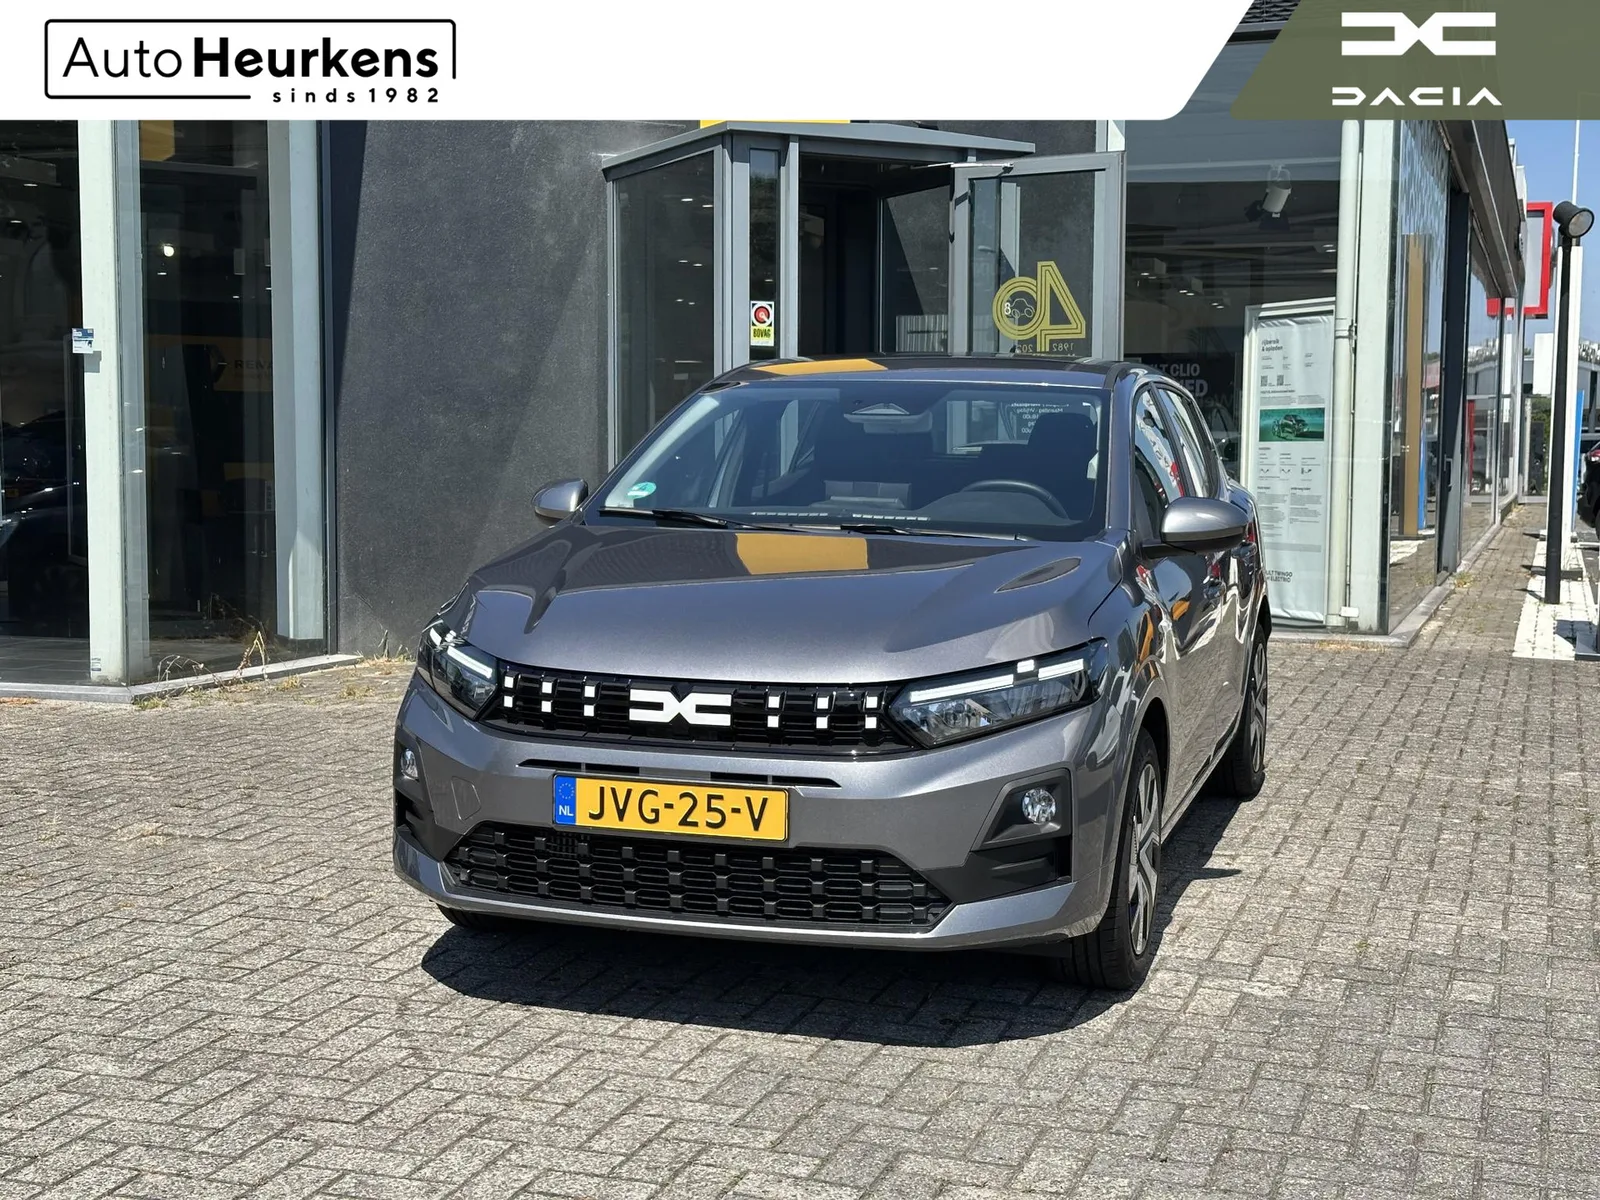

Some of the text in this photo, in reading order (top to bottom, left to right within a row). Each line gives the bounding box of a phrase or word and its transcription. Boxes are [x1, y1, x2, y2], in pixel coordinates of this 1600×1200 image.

[753, 328, 771, 338] BOVAG
[1169, 363, 1201, 377] CLIO
[558, 786, 769, 832] NL JVG-25-V
